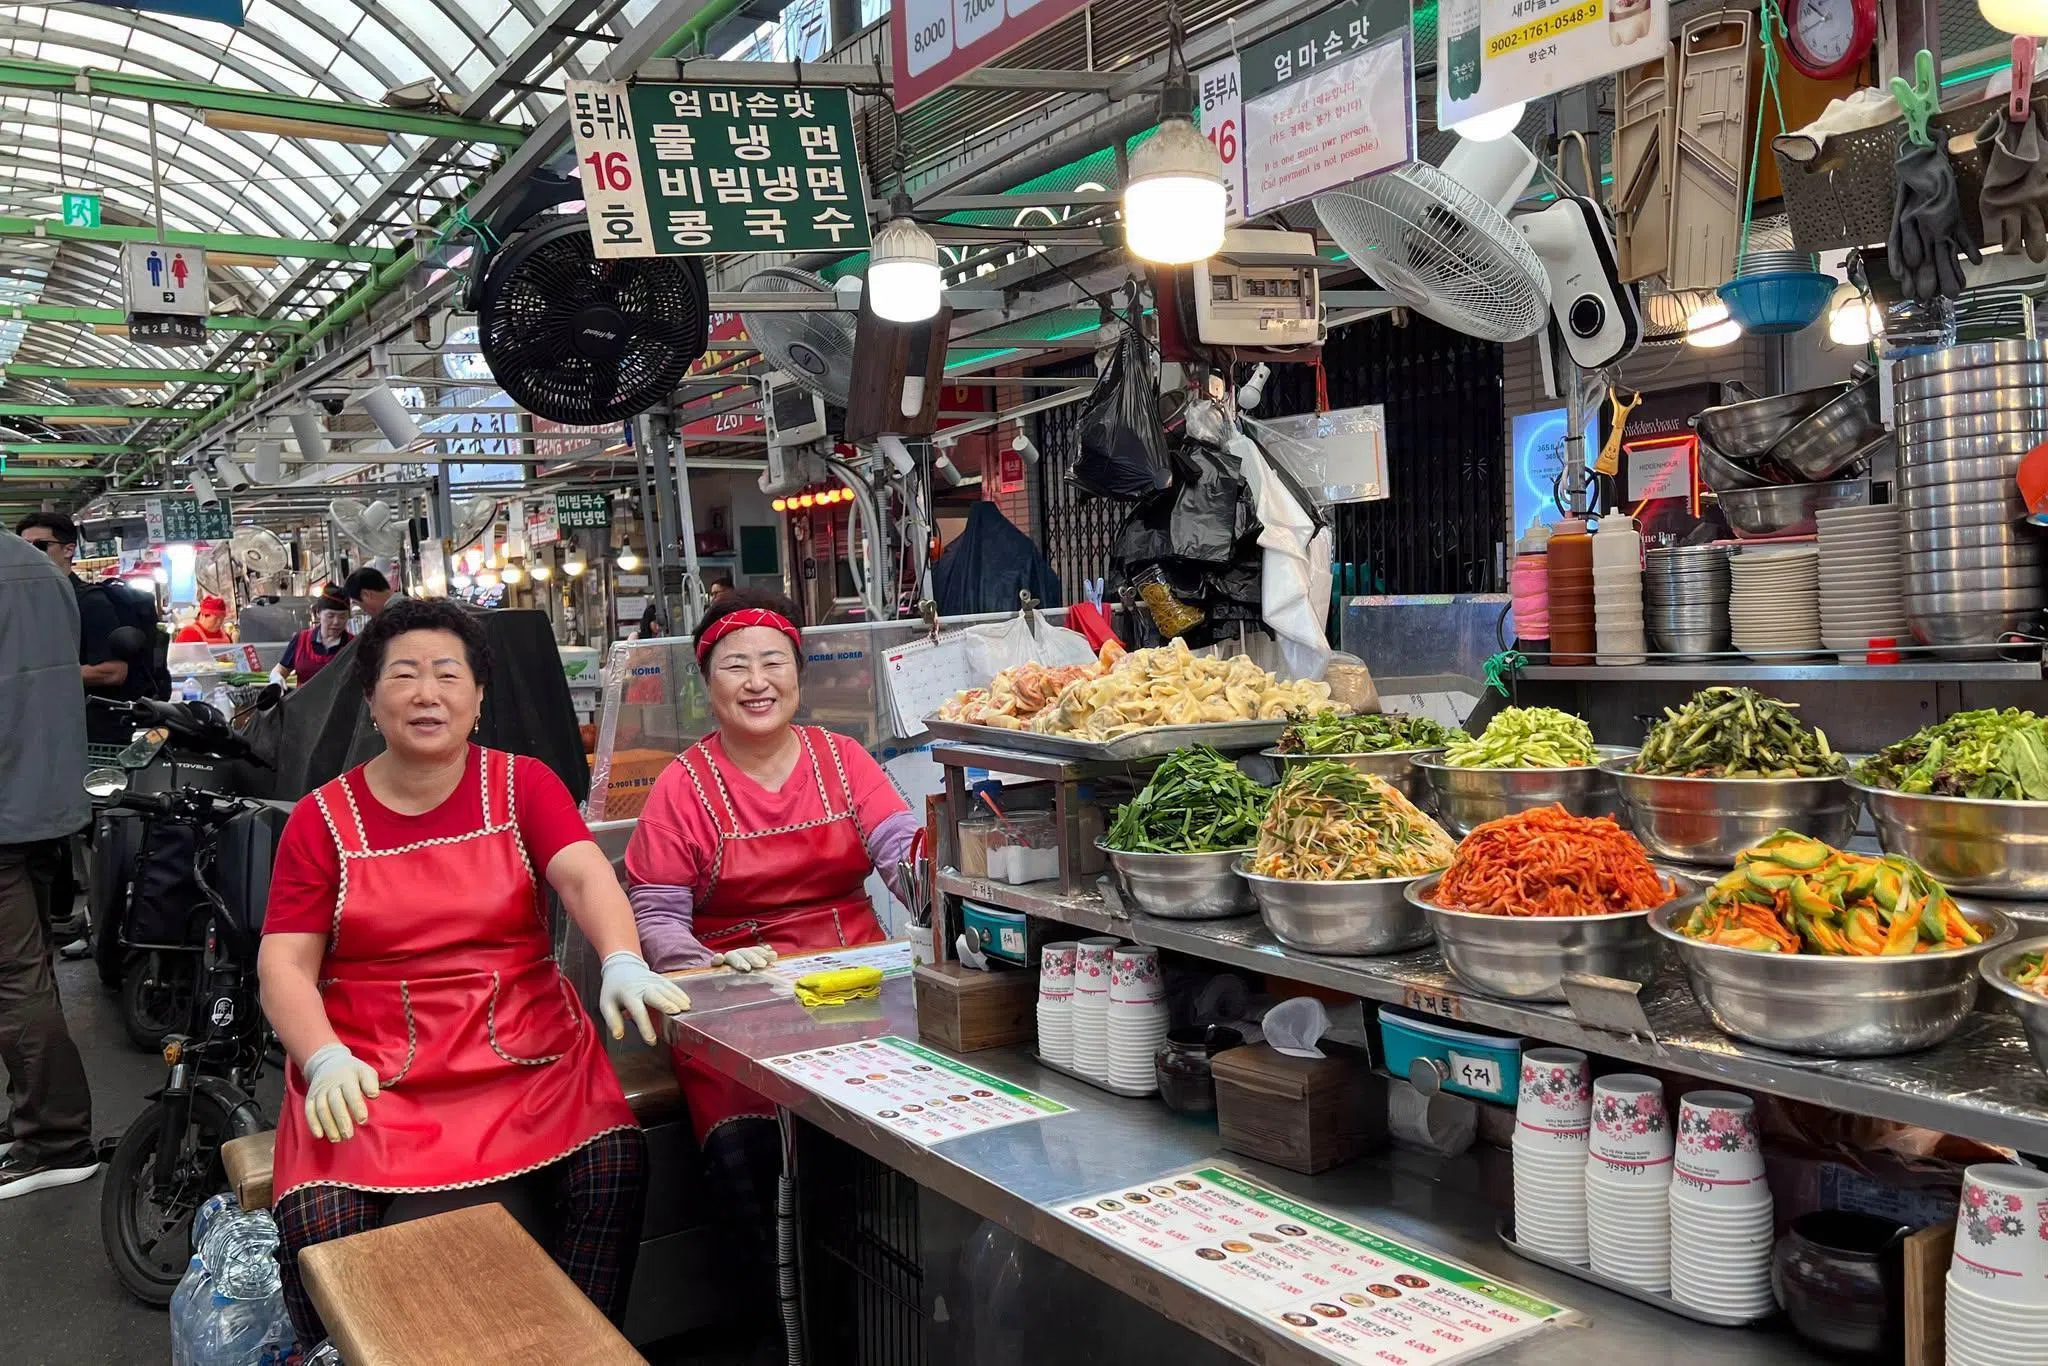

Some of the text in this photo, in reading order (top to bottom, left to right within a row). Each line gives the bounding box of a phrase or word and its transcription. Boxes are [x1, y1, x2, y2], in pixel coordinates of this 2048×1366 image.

[914, 18, 946, 53] 8,000
[1491, 5, 1597, 53] 9002-1761-0548-9
[1274, 15, 1370, 82] 엄마손맛
[1528, 44, 1557, 64] 방순자
[1203, 72, 1238, 112] 동부A
[668, 90, 816, 119] 엄마손맛
[575, 93, 631, 140] 동부A
[1281, 153, 1295, 165] one
[1297, 144, 1319, 160] menu
[584, 151, 632, 191] 16
[1279, 165, 1310, 186] payment
[1313, 161, 1321, 171] is
[1324, 154, 1337, 168] not
[657, 166, 848, 204] 비빔냉면
[600, 204, 643, 245] 호
[169, 501, 223, 514] 수정
[558, 494, 605, 510] 비빔국수
[559, 510, 606, 526] 비빔냉면
[1640, 533, 1656, 544] ine
[838, 650, 863, 660] KOREA
[631, 666, 661, 676] KOREA
[895, 663, 901, 671] 6
[163, 762, 213, 771] MTOVELO
[1462, 1064, 1491, 1087] 수저
[1606, 1162, 1645, 1176] Classic
[1679, 1175, 1712, 1193] Classic
[1408, 1296, 1493, 1333] 비빔국수 8,000
[1487, 1309, 1520, 1324] 8,000
[1353, 1315, 1438, 1355] 비빔냉면 8,000
[1432, 1328, 1465, 1343] 8,000
[1375, 1349, 1409, 1365] 8,000
